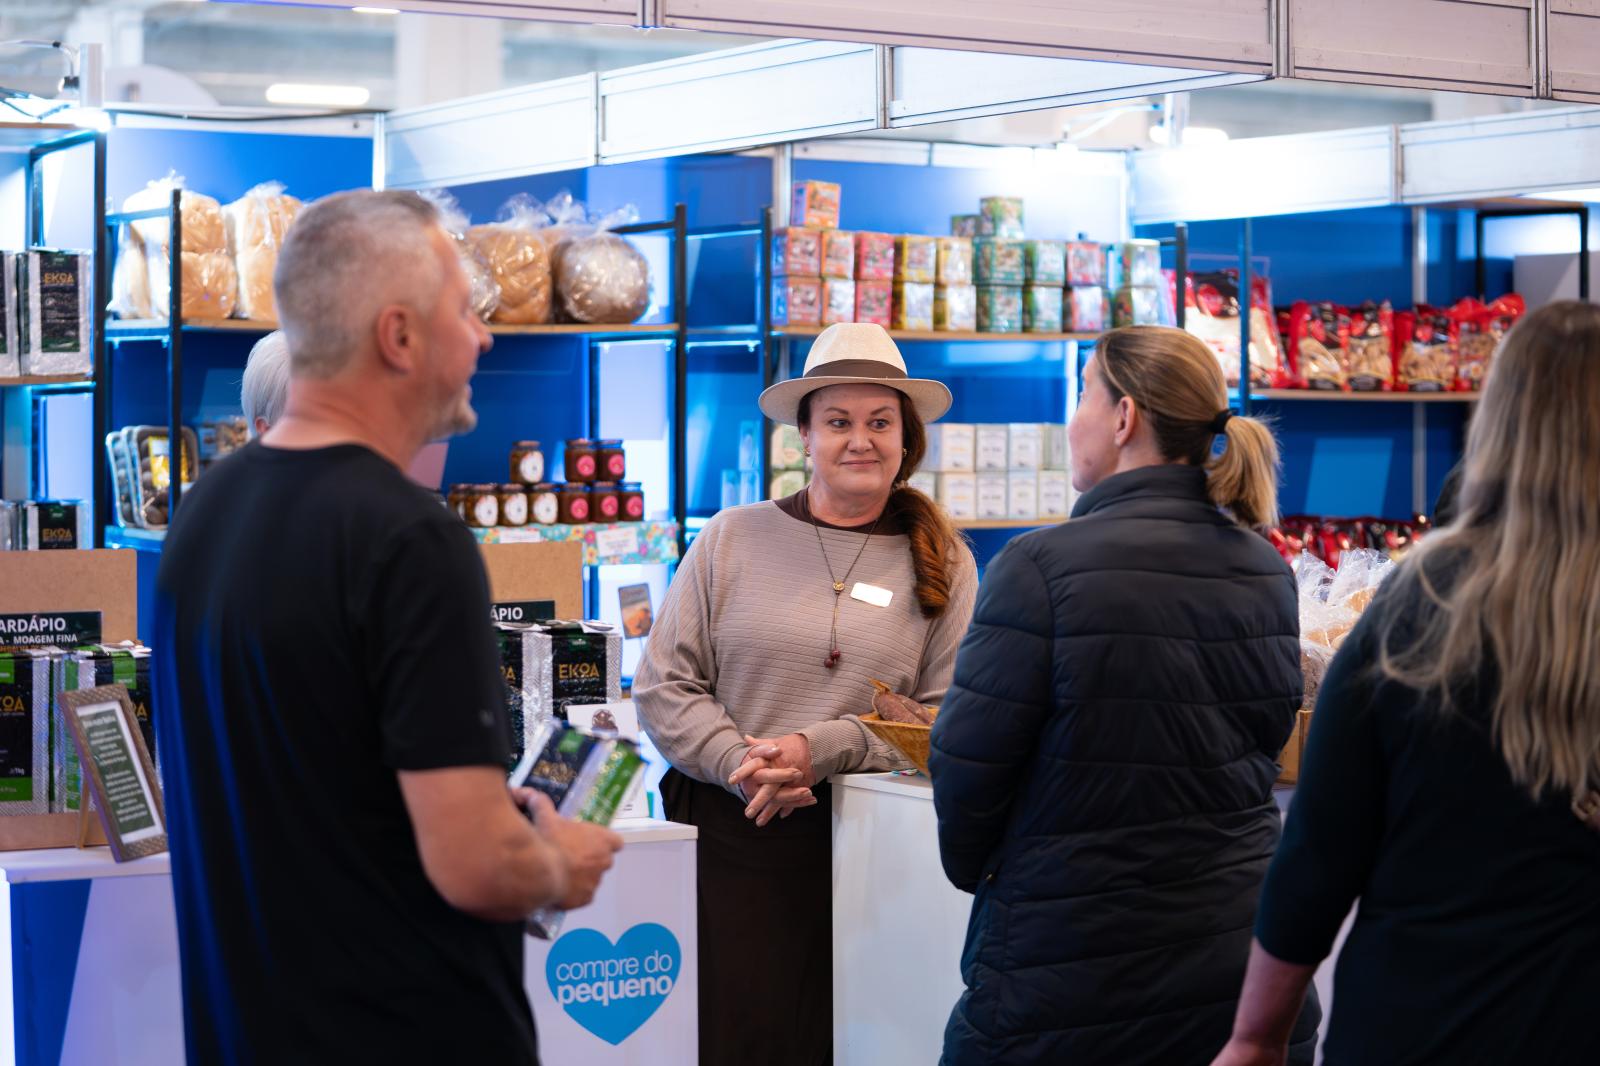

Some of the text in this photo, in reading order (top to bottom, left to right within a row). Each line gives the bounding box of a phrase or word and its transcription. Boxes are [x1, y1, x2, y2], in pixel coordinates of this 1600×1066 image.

[13, 635, 54, 644] MOAGEM
[56, 634, 78, 642] FINA
[559, 662, 600, 679] EKOA
[0, 696, 24, 711] OA
[556, 950, 673, 982] compre do
[557, 975, 673, 1007] pequeno
